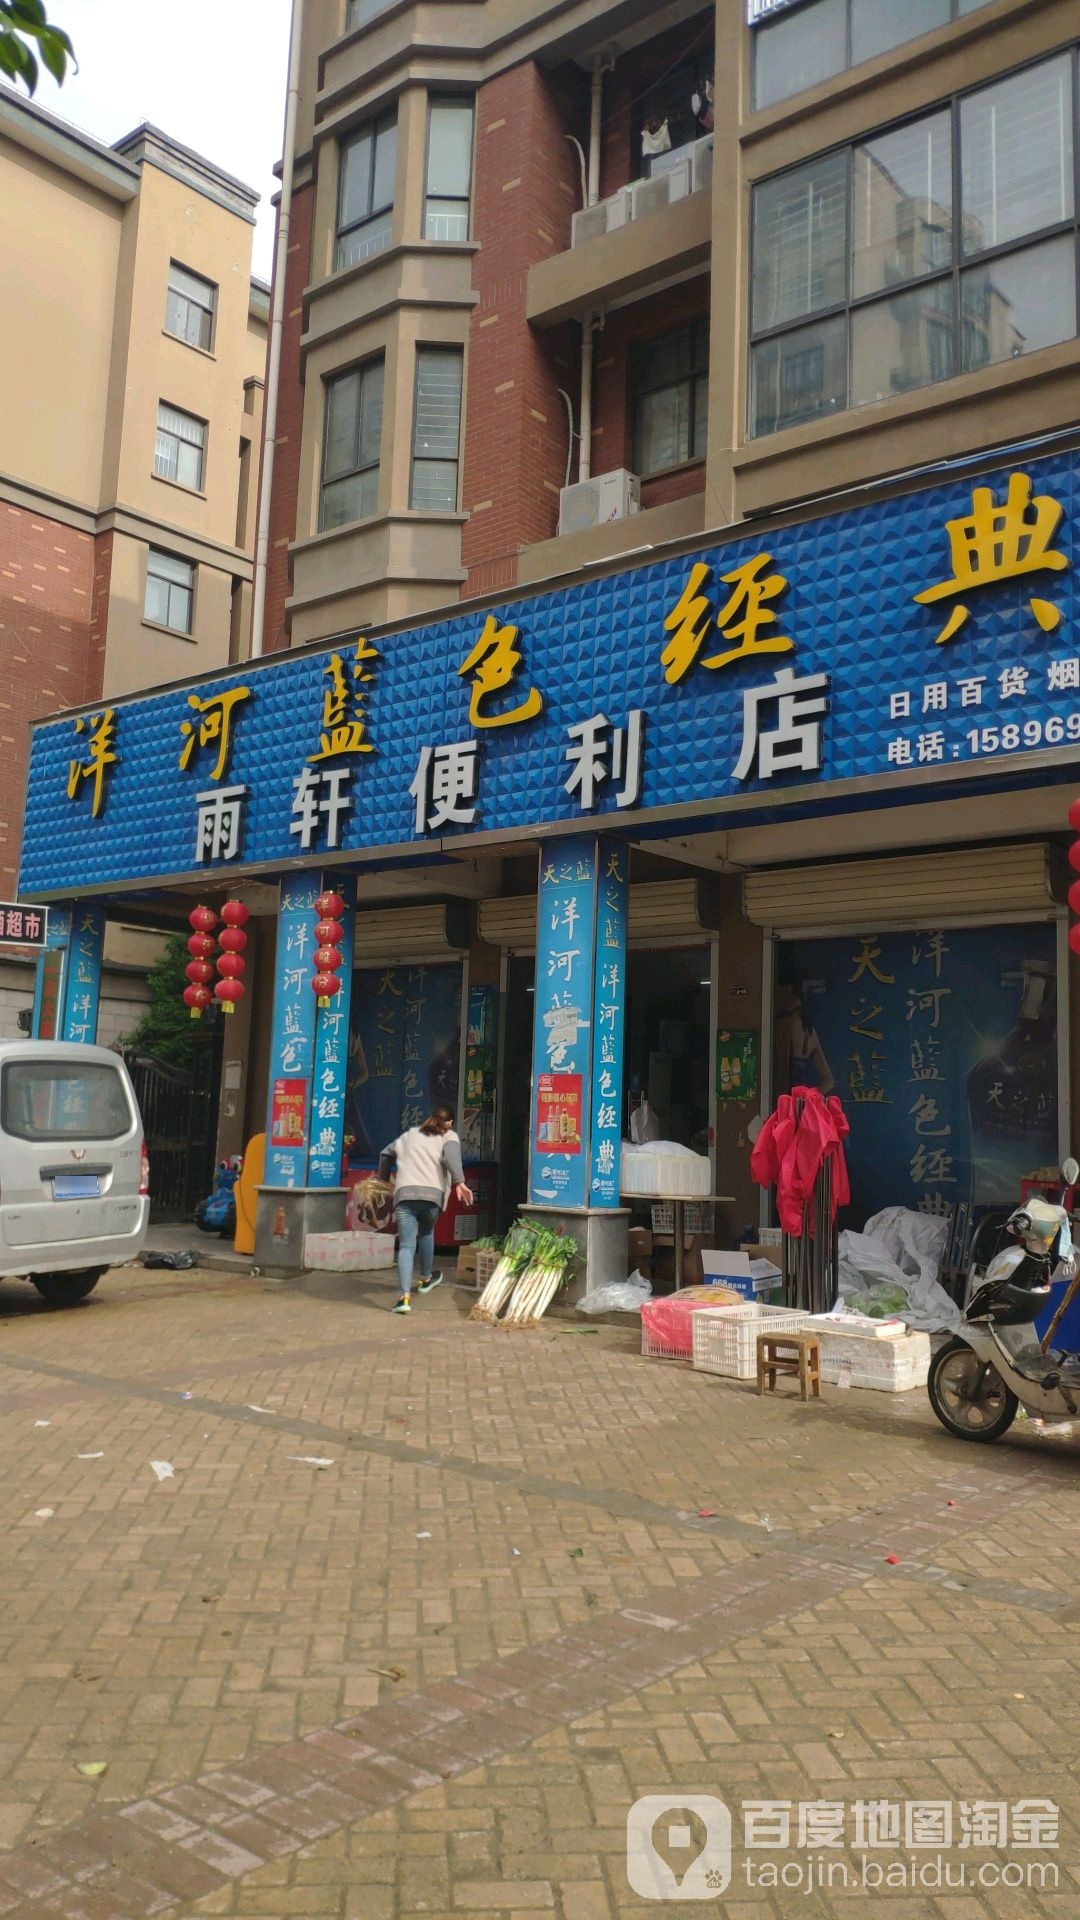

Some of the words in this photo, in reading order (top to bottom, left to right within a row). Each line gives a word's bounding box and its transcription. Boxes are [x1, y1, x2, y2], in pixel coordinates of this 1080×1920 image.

[889, 666, 1029, 720] 日用百货
[1047, 658, 1080, 692] 烟
[194, 666, 831, 862] 雨轩便利店
[0, 910, 41, 939] 超市
